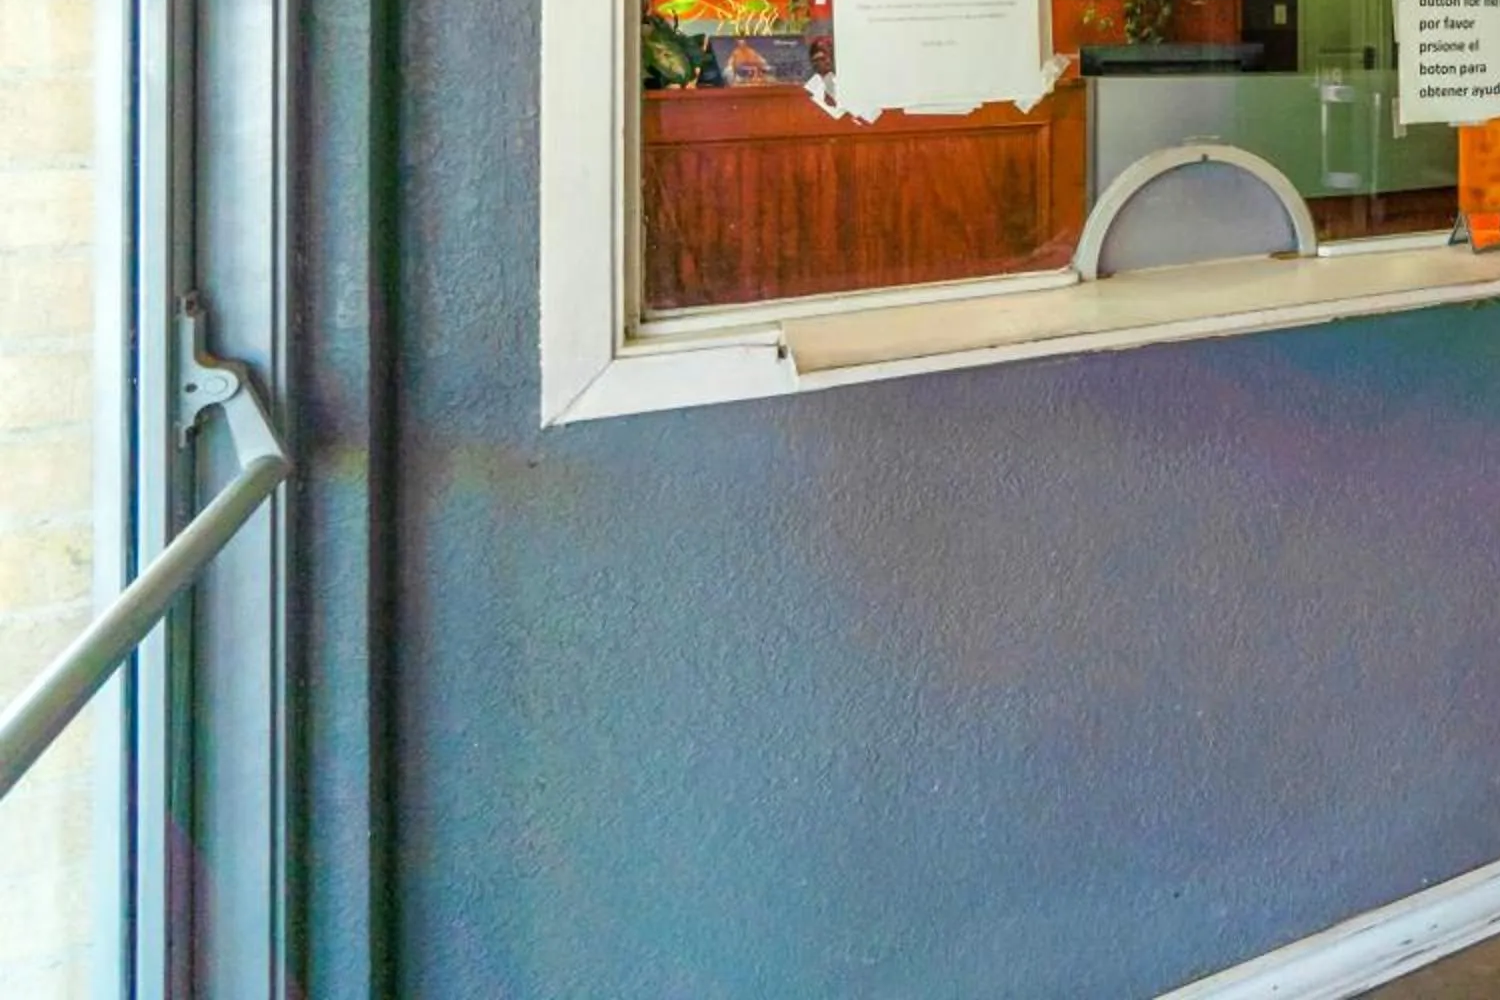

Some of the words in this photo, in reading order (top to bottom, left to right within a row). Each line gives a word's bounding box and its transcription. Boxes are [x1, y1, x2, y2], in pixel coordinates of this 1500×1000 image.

[1419, 19, 1440, 32] por
[1443, 16, 1476, 29] favor
[1419, 39, 1466, 55] prsione
[1468, 38, 1480, 52] el
[1419, 61, 1457, 75] boton
[1459, 63, 1487, 76] para
[1419, 85, 1468, 98] obtener
